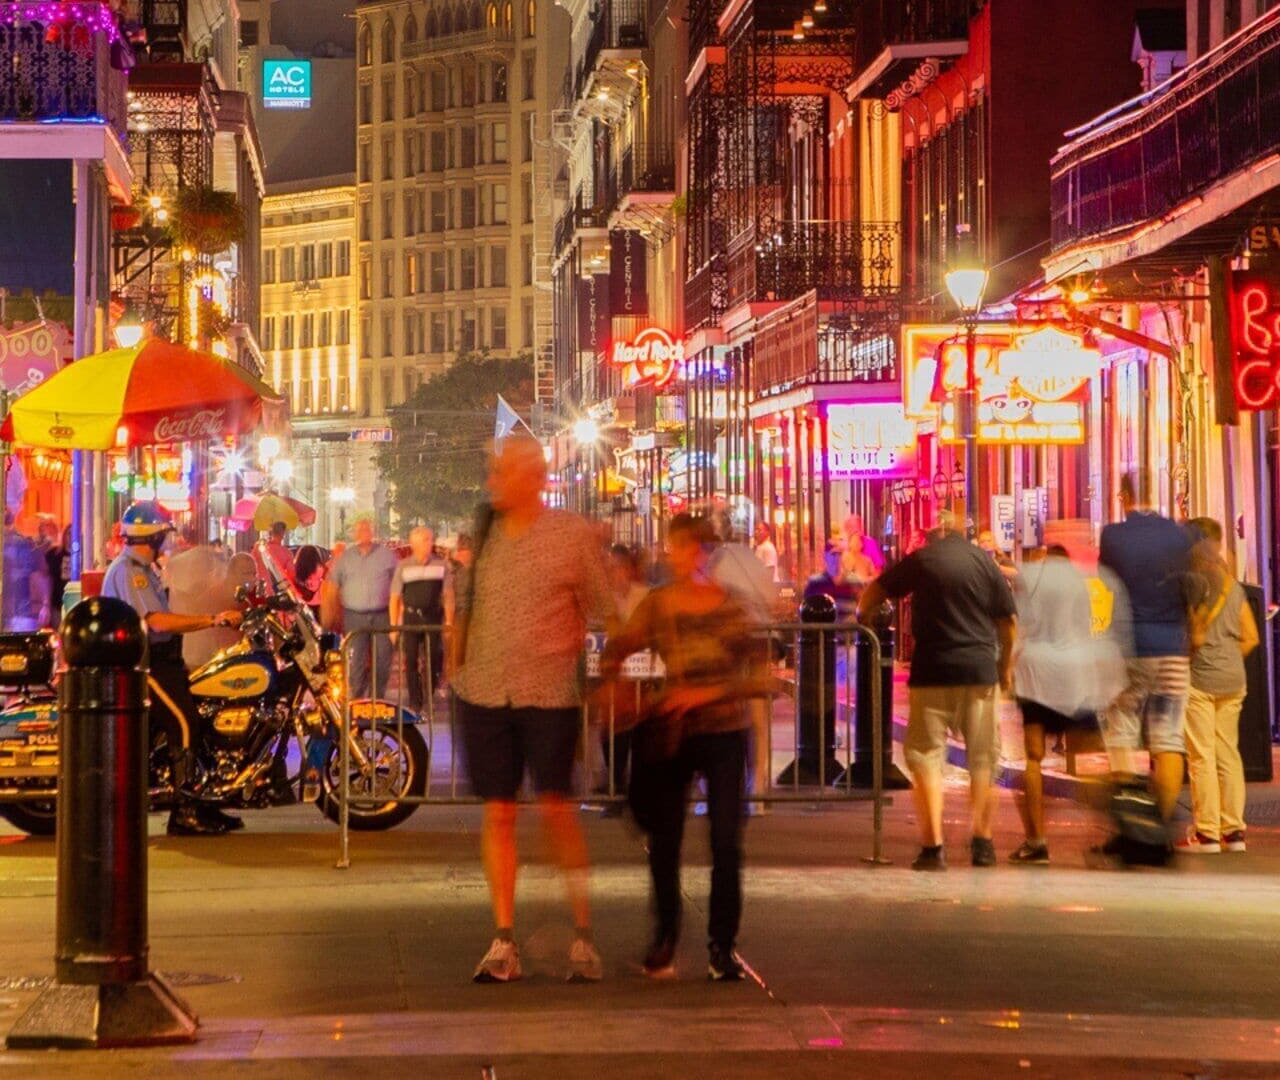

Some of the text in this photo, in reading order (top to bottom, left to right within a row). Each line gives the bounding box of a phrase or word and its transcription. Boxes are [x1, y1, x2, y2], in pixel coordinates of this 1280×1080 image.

[269, 66, 305, 86] AC
[269, 86, 305, 94] HOTELS
[613, 339, 685, 363] Hard Rock
[153, 407, 226, 443] Coca-Cola
[28, 734, 59, 745] POLI
